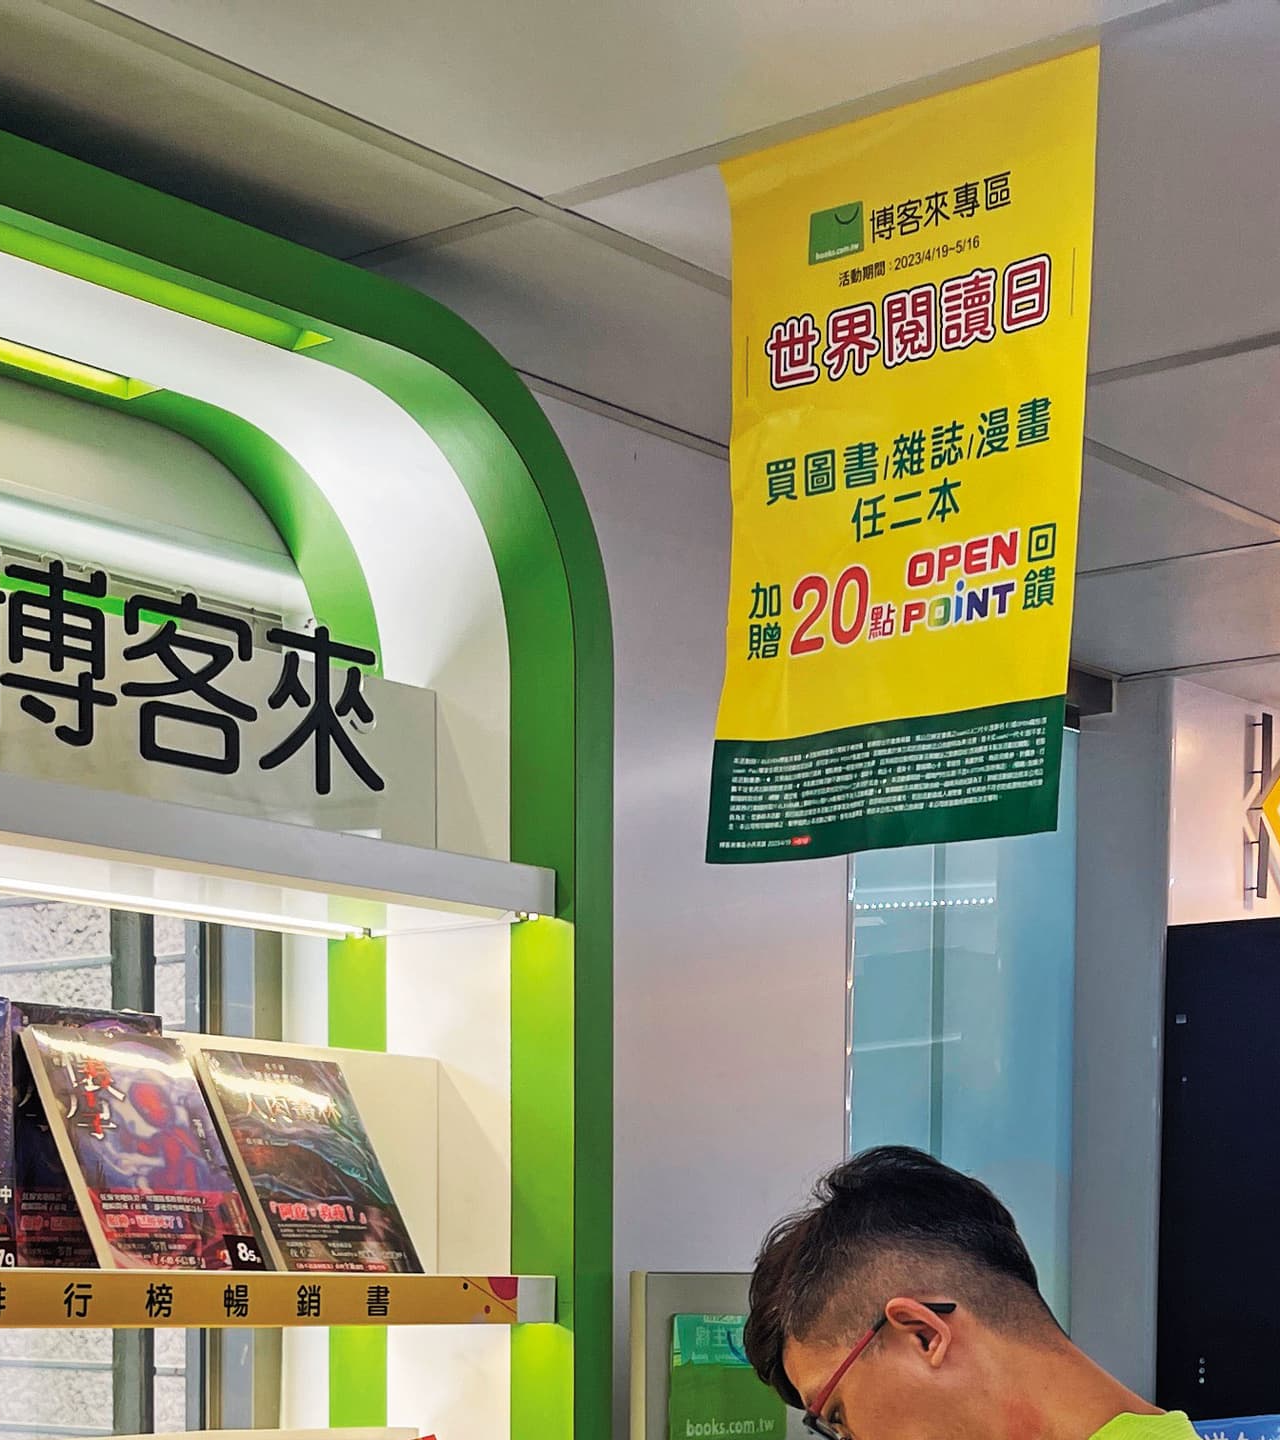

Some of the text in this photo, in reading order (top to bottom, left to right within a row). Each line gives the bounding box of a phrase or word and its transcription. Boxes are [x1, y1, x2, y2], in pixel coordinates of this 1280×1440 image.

[870, 170, 1012, 242] 博客來專區
[765, 254, 1051, 390] 世界閱讀日
[765, 396, 1051, 505] 買圖書/雜誌/漫畫
[851, 476, 960, 543] 任二本
[907, 530, 1019, 587] OPEN
[685, 1417, 775, 1438] books.com.tw
